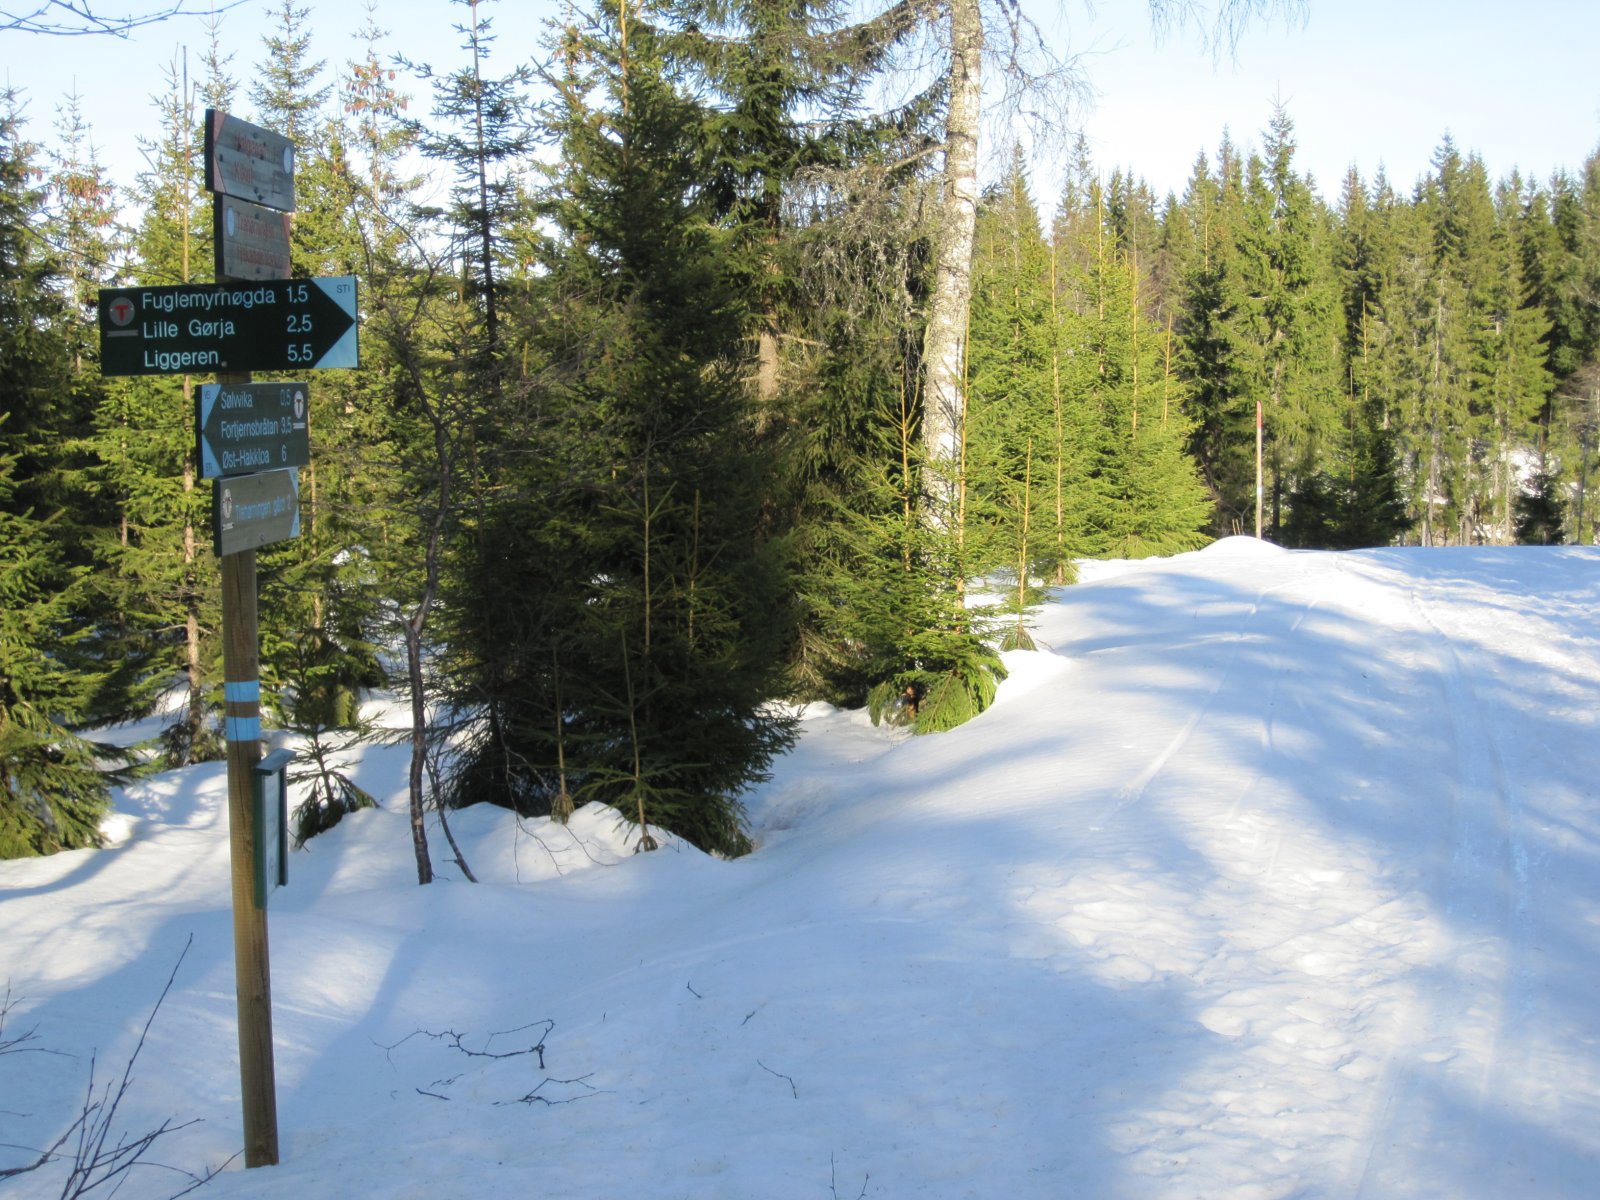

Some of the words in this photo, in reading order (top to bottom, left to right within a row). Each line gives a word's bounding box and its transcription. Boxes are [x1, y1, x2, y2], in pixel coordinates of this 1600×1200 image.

[336, 284, 351, 293] STI
[143, 321, 178, 339] Lille
[188, 319, 236, 339] Gørja
[286, 314, 312, 333] 2,5
[144, 350, 219, 370] Liggeren
[287, 344, 313, 362] 5,5
[281, 444, 288, 462] 6
